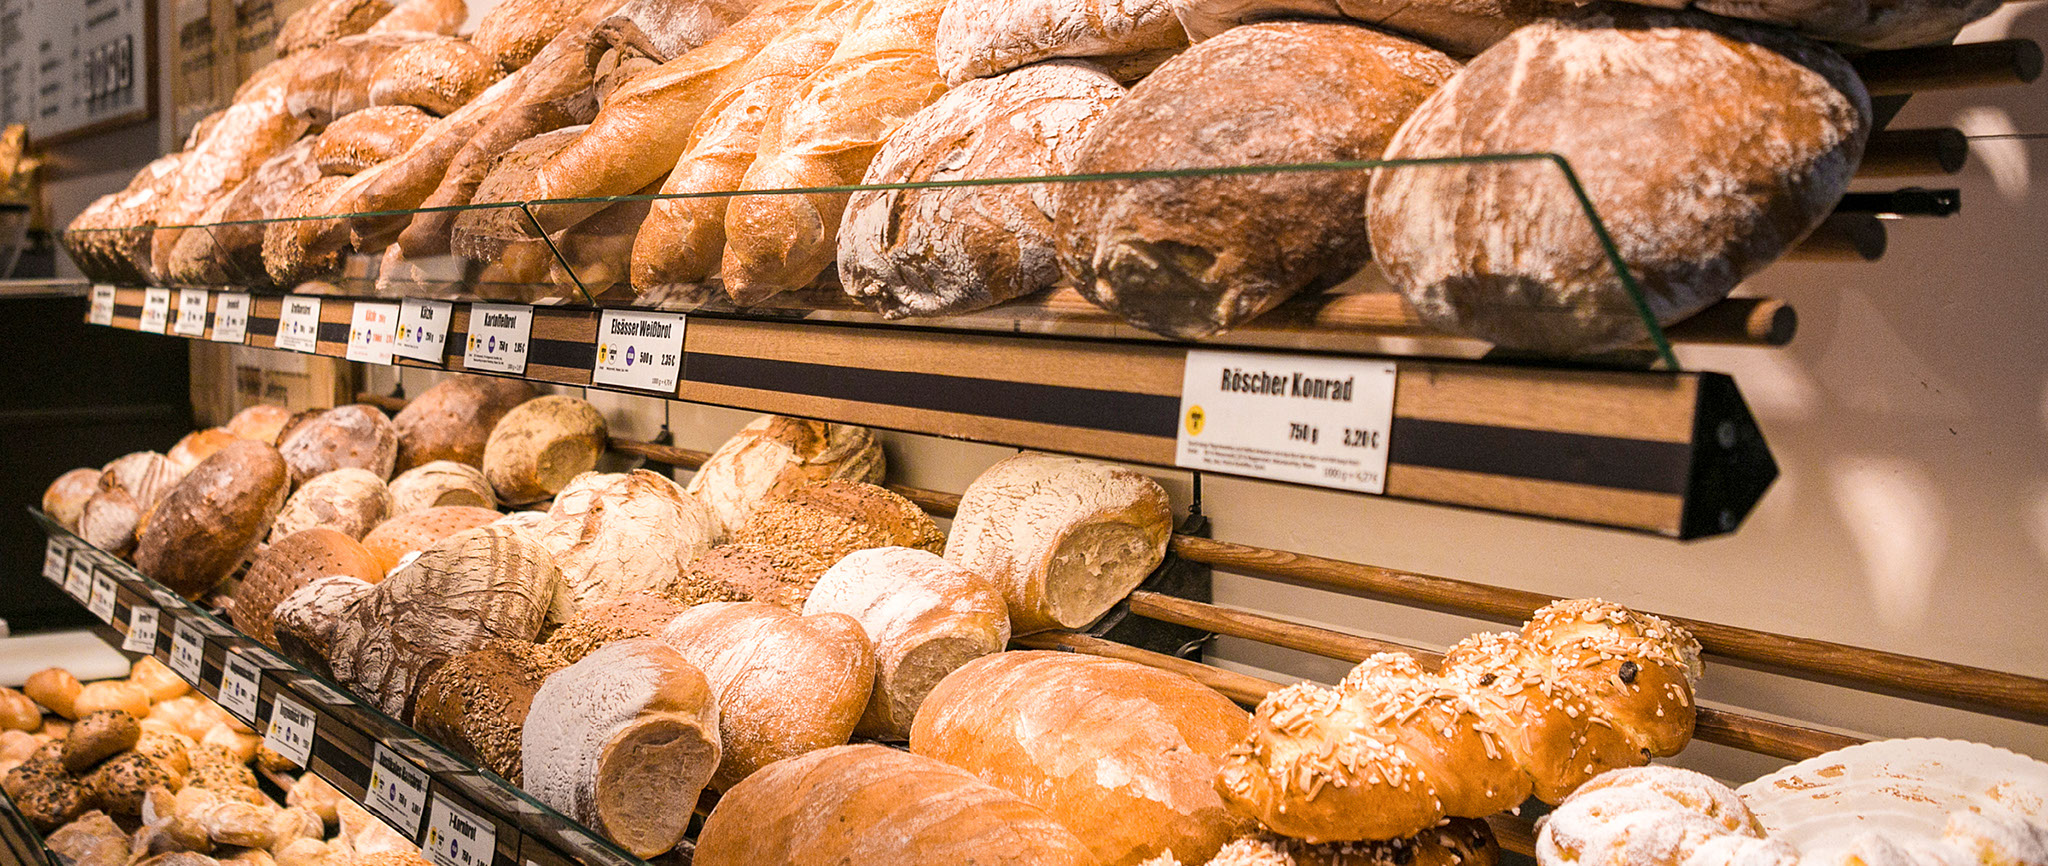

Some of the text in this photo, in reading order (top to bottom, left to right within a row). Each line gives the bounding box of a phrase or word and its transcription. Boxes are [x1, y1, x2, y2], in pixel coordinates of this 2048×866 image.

[611, 318, 672, 339] Elsässer Weißbrot
[640, 352, 653, 366] 500 g
[1221, 368, 1355, 402] Röscher Konrad
[1289, 423, 1319, 445] 750 g
[1343, 428, 1380, 449] 3,20 €
